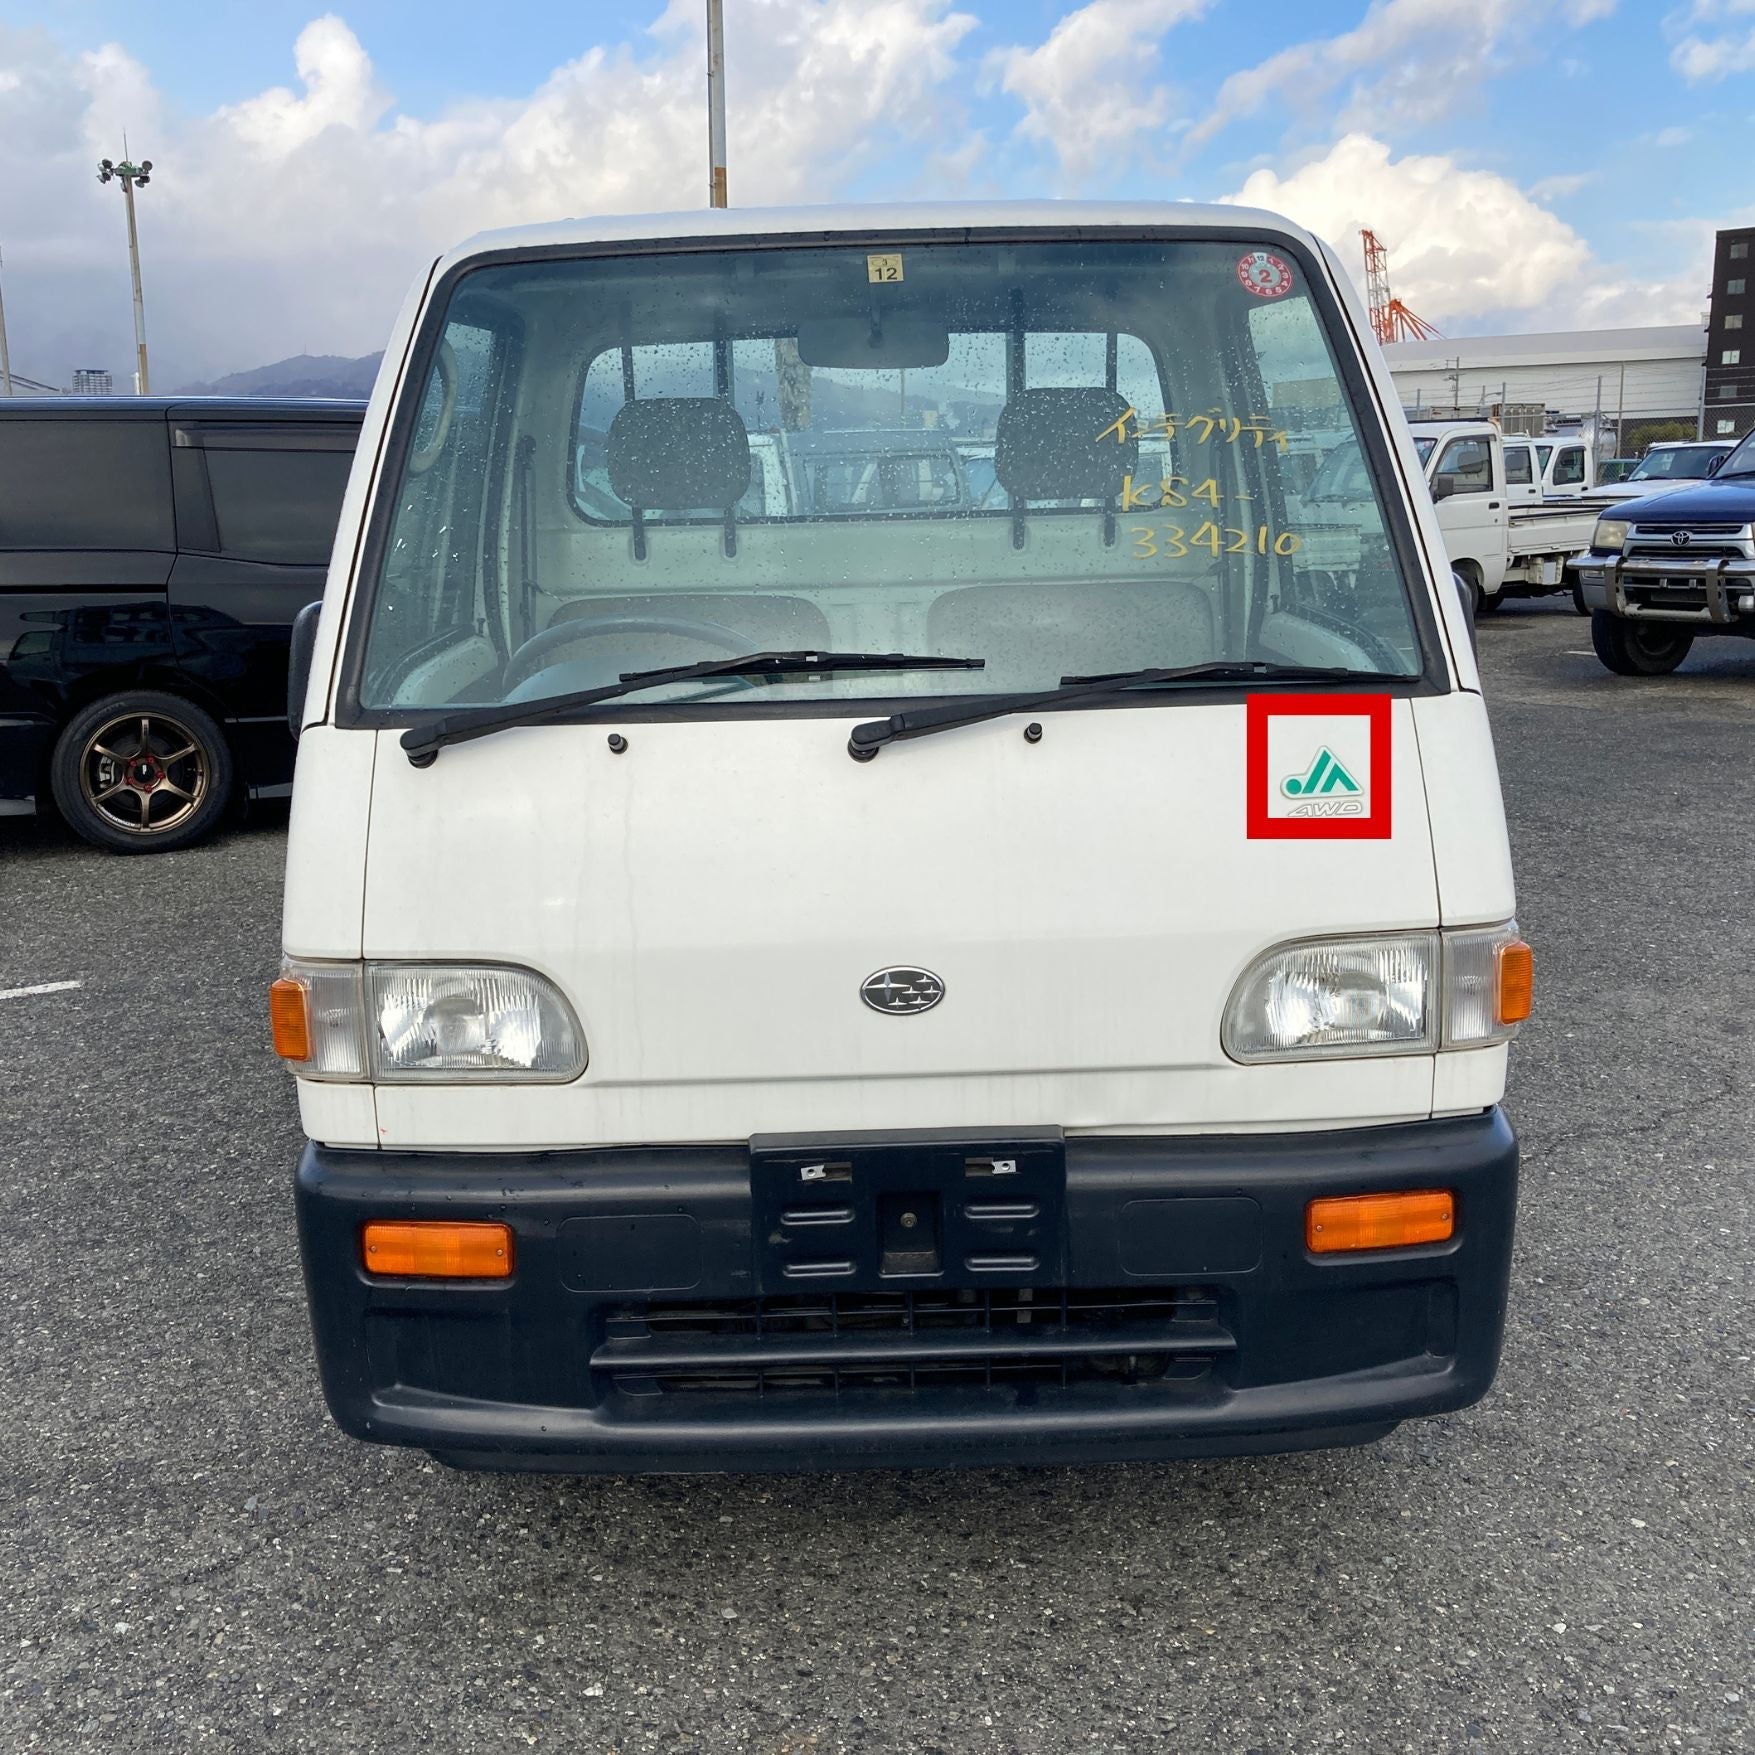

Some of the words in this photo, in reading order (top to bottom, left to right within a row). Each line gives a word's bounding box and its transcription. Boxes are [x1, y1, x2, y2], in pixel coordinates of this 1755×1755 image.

[875, 267, 898, 281] 12
[1258, 269, 1273, 283] 2
[1130, 520, 1302, 559] 334210
[1287, 800, 1362, 817] AWD
